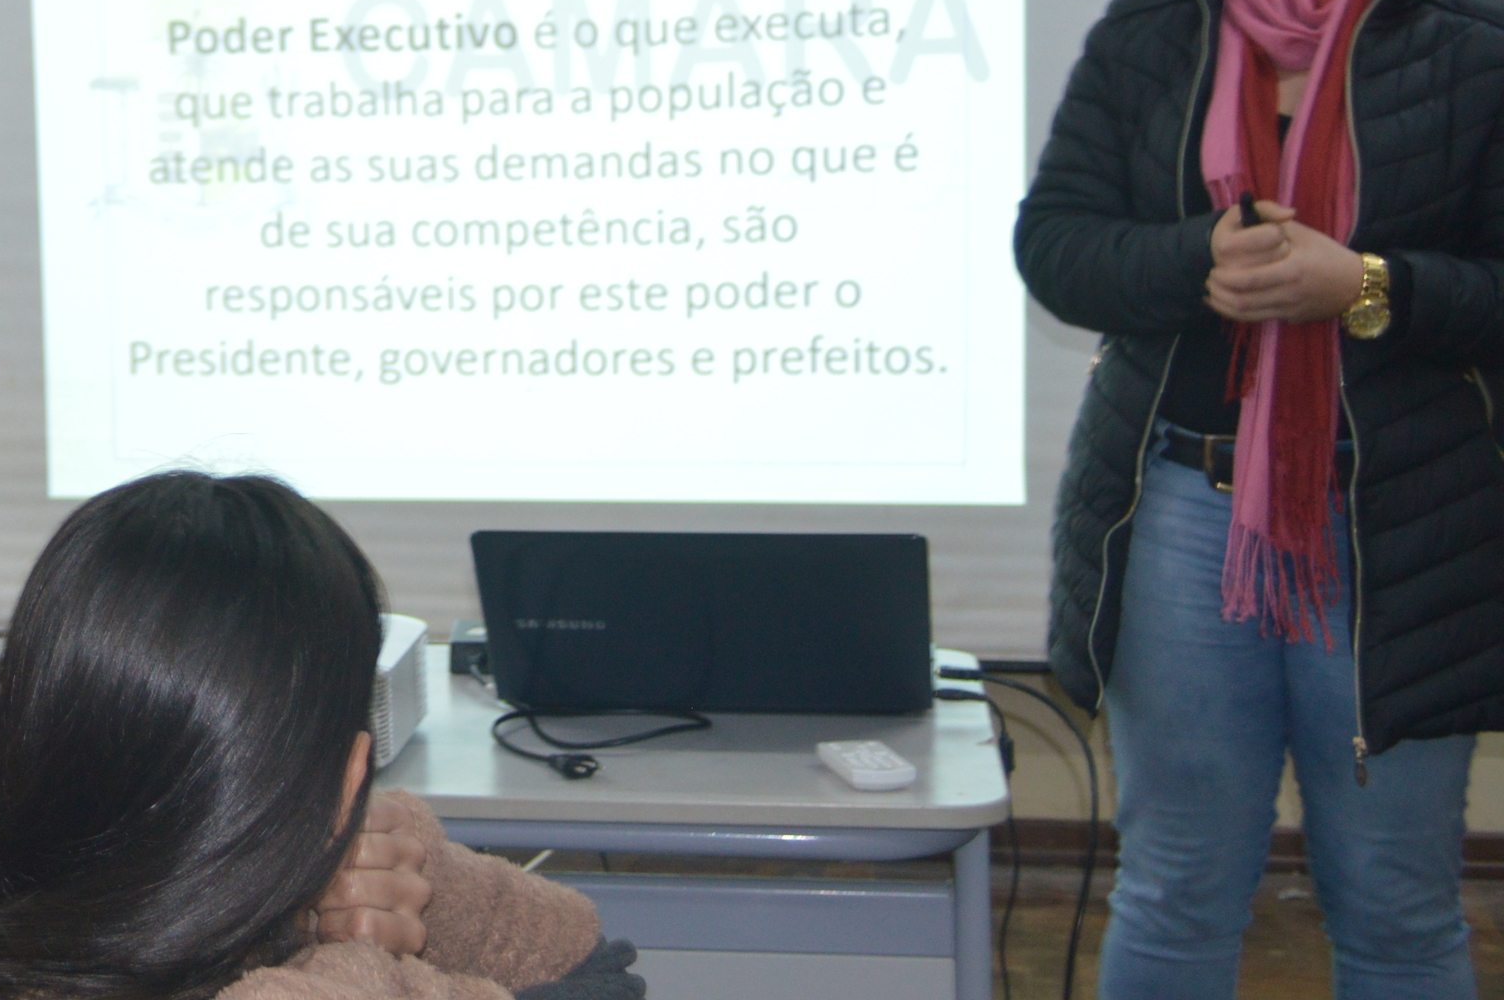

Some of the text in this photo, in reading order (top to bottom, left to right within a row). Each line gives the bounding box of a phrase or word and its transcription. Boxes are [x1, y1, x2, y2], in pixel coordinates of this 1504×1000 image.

[167, 3, 907, 56] Poder Executivo é o que executa,
[174, 68, 886, 128] que trabalha para a população e
[150, 134, 918, 185] atende as suas demandas no que é
[261, 206, 797, 255] de sua competência, são
[206, 272, 861, 318] responsáveis por este poder o
[129, 335, 946, 385] Presidente, governadores e prefeitos.
